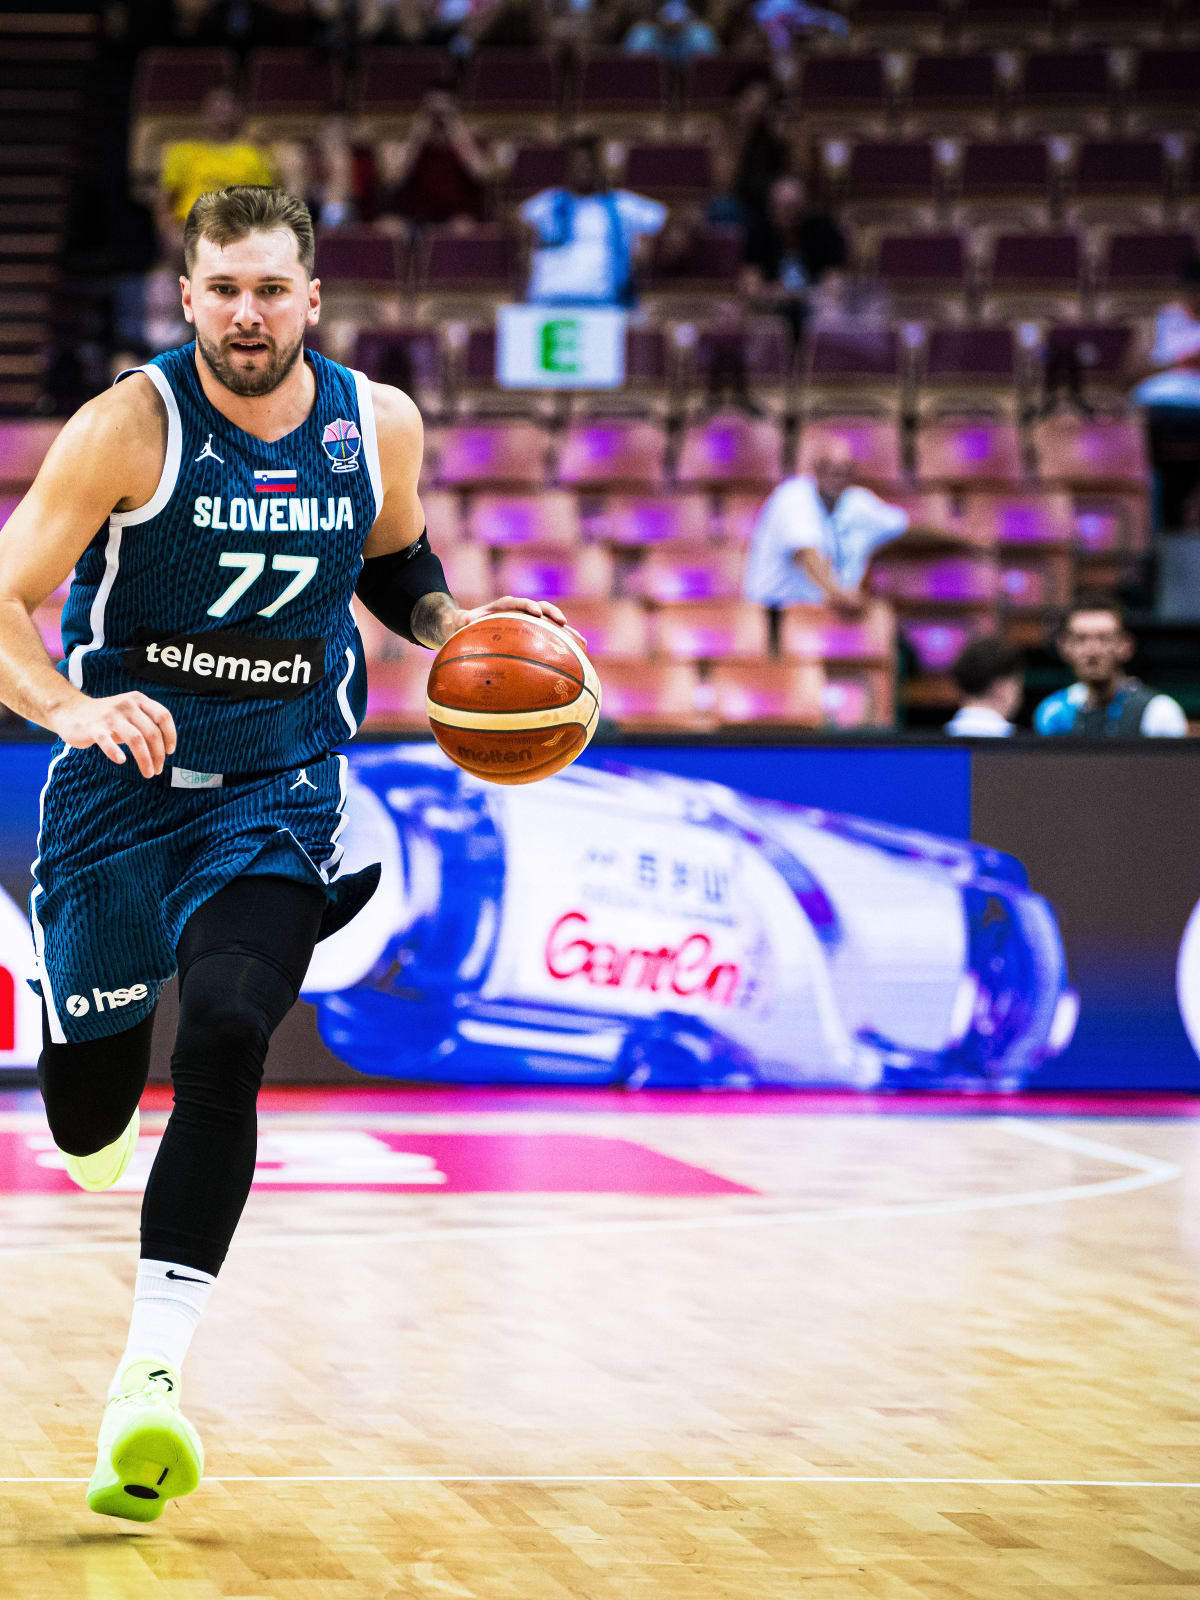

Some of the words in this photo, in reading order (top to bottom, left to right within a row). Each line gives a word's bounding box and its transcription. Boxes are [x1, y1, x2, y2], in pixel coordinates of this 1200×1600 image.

[540, 319, 578, 373] E
[193, 496, 354, 532] SLOVENIJA
[206, 552, 319, 618] 77
[146, 643, 312, 684] telemach
[457, 746, 534, 764] molten
[92, 983, 149, 1013] hse
